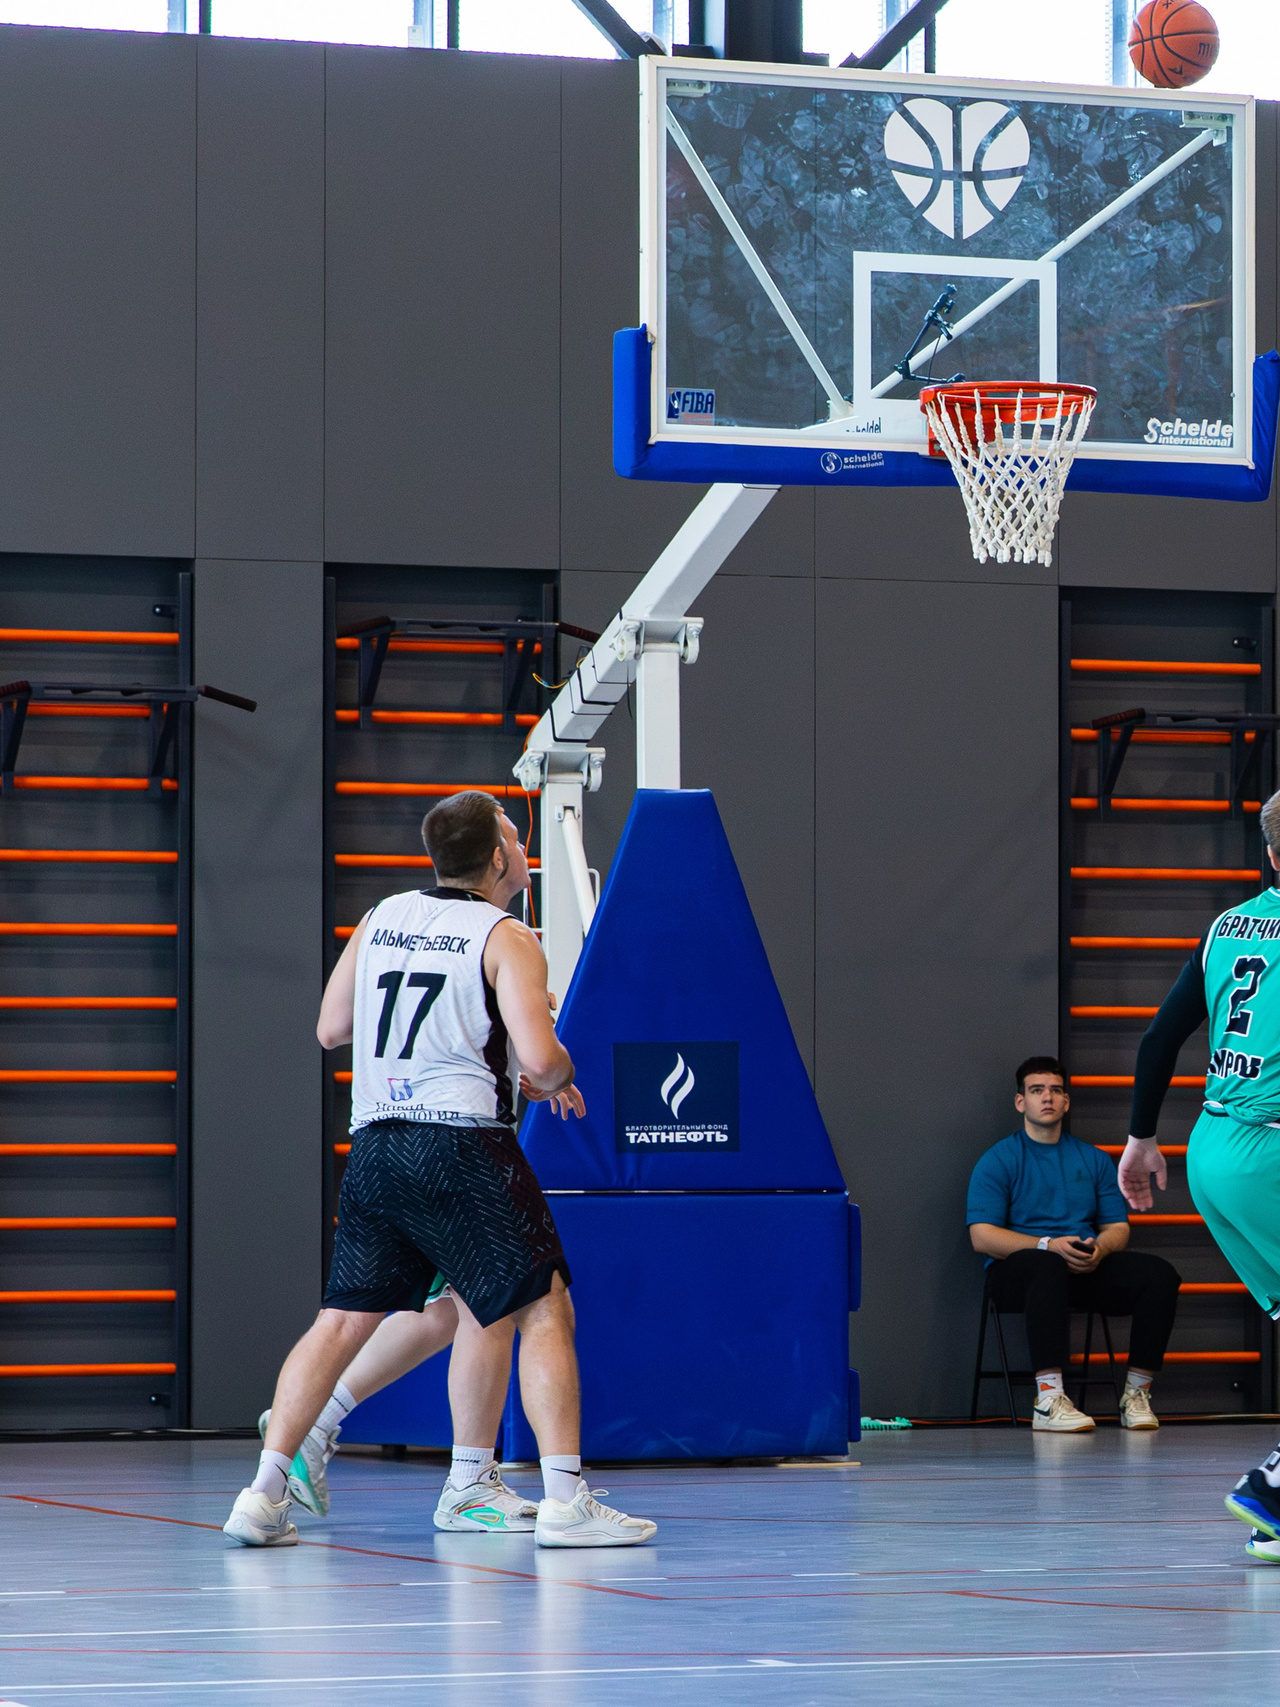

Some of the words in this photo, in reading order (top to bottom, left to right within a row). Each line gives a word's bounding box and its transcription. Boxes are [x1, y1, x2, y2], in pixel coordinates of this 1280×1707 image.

[681, 391, 714, 414] FIBA
[1144, 417, 1234, 443] Schelde
[1158, 434, 1232, 447] international
[843, 452, 883, 464] schelde
[370, 928, 471, 955] АЛЬМЕТЬЕВСК
[1223, 955, 1269, 1037] 2
[374, 970, 447, 1060] 17
[625, 1124, 706, 1132] БЛАГОТВОРИТЕЛЬНЫЙ
[625, 1131, 728, 1143] ТАТНЕФТЬ
